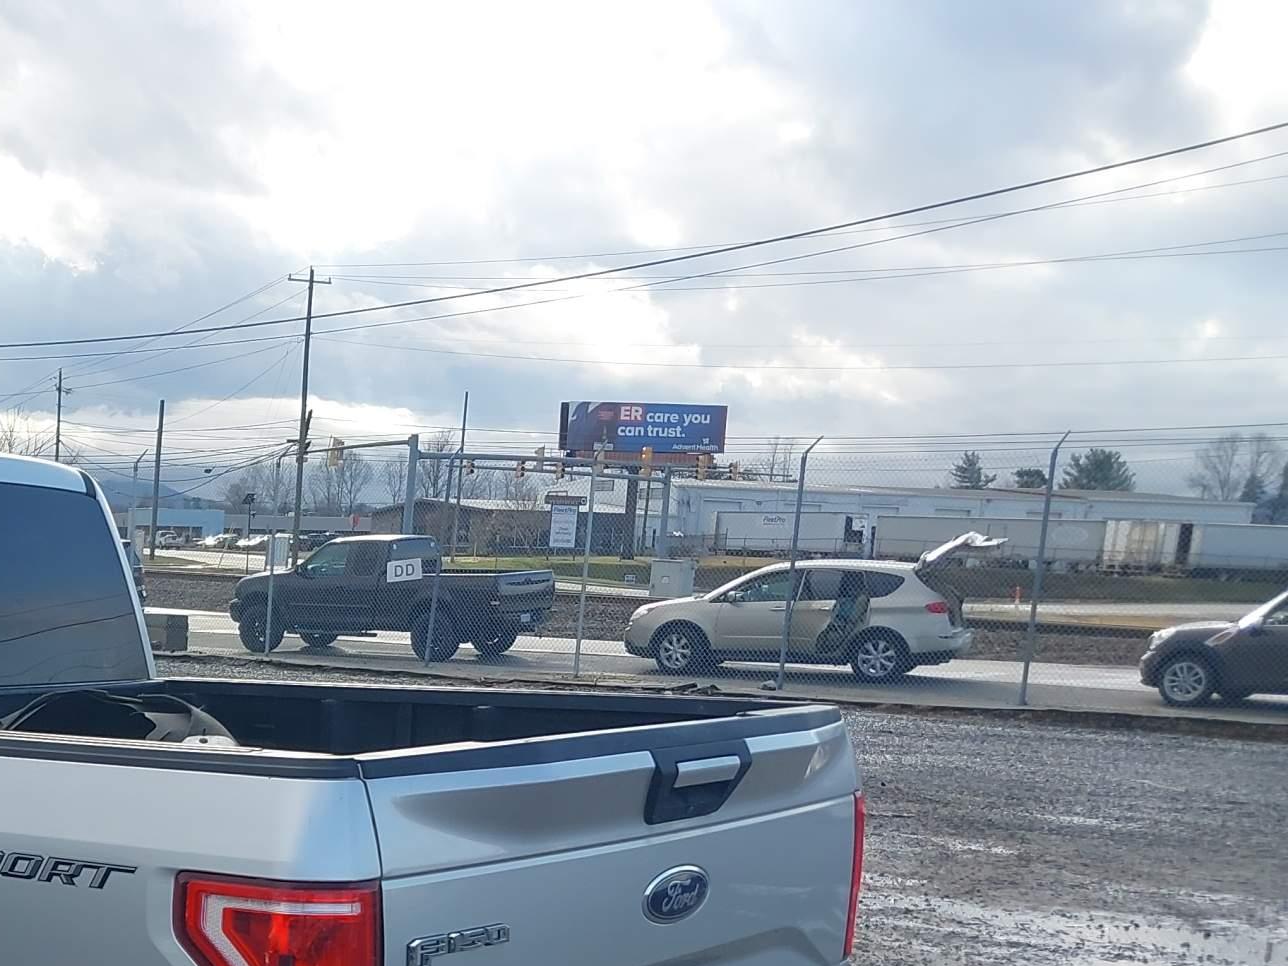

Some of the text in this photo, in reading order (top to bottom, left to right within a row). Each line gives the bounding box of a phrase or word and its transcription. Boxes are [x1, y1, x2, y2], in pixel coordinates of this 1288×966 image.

[620, 406, 643, 421] ER
[646, 412, 678, 423] care
[683, 412, 711, 426] you
[617, 425, 686, 438] can trust.
[394, 564, 415, 577] DD
